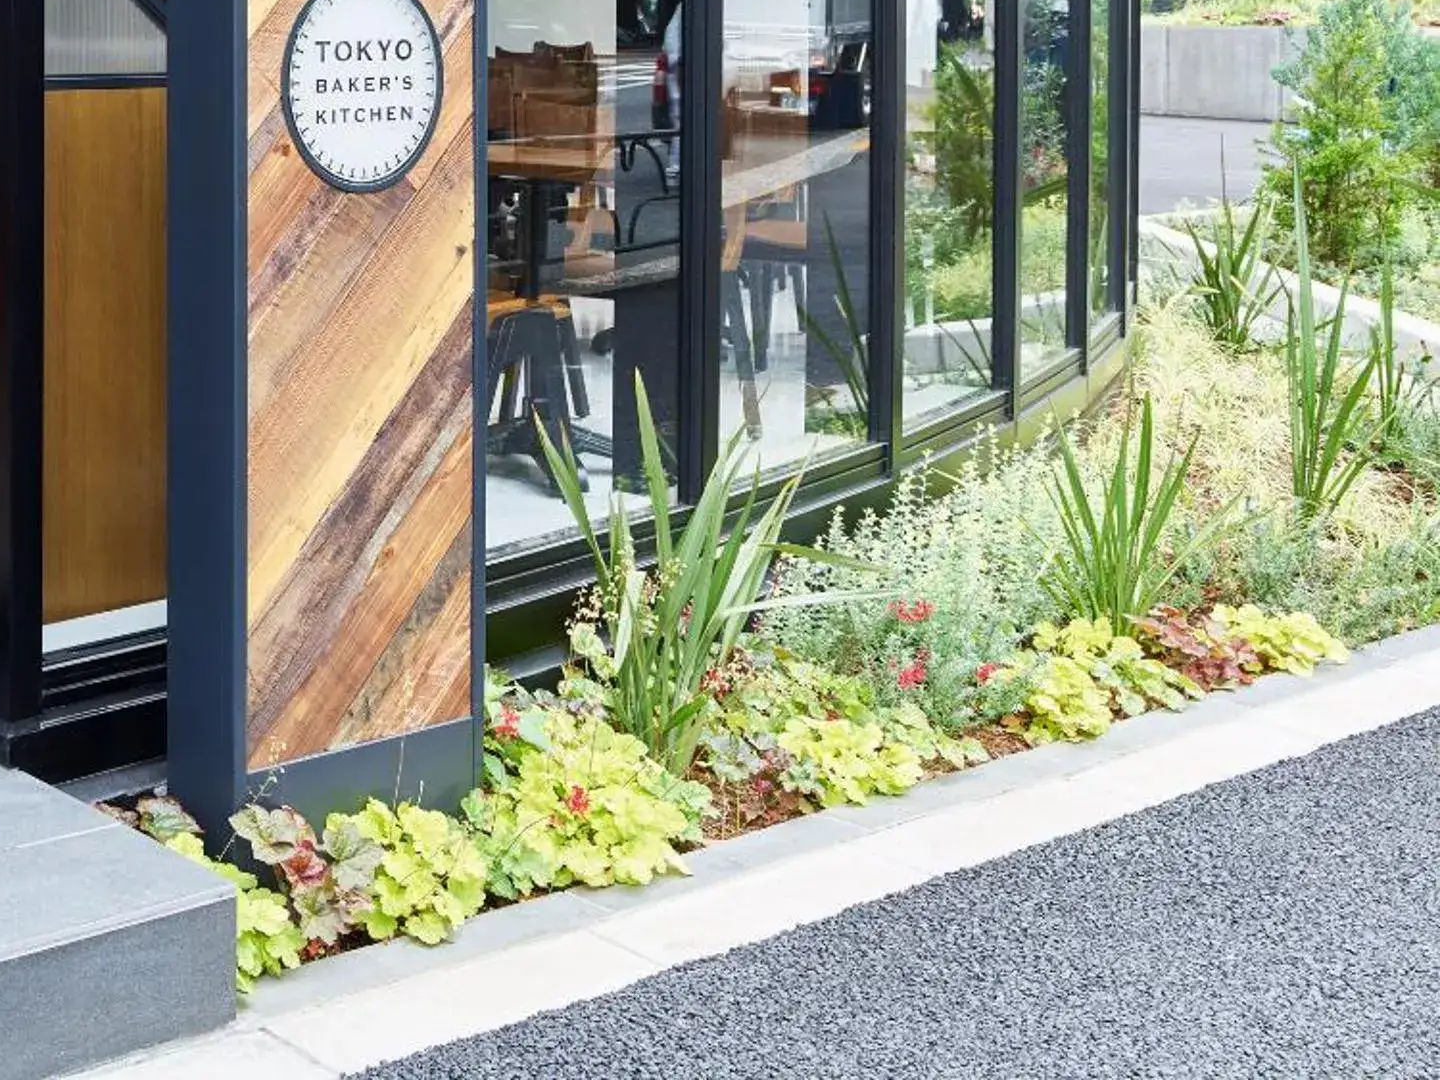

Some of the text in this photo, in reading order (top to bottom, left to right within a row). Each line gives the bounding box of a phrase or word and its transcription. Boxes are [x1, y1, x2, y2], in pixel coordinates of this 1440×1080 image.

[315, 39, 413, 62] TOKYO
[316, 76, 413, 94] BAKER'S
[315, 106, 413, 124] KITCHEN
